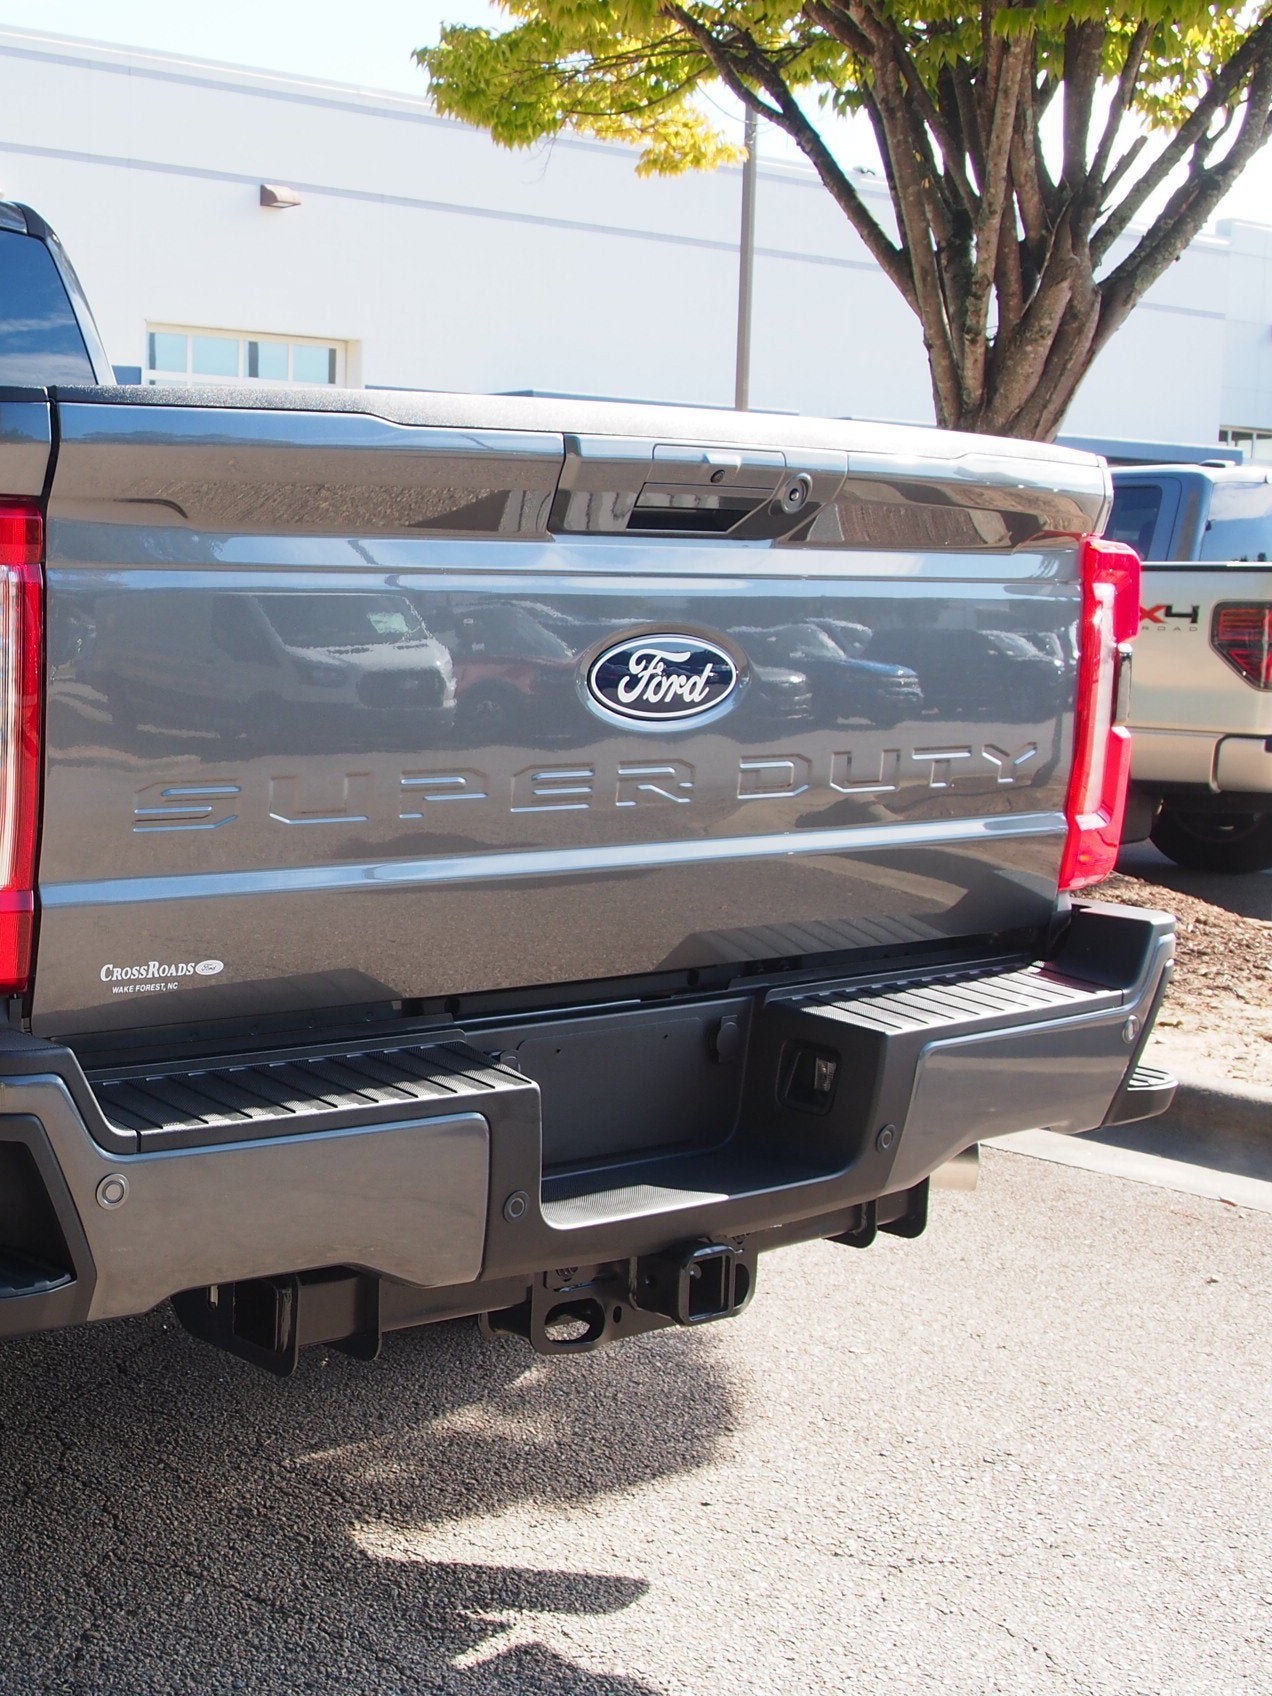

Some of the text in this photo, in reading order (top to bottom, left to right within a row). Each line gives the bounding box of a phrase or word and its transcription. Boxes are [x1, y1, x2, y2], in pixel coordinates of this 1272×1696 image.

[617, 647, 715, 704] Ford
[131, 741, 1039, 832] SUPER DUTY
[112, 982, 179, 994] WAKE FOREST, NC
